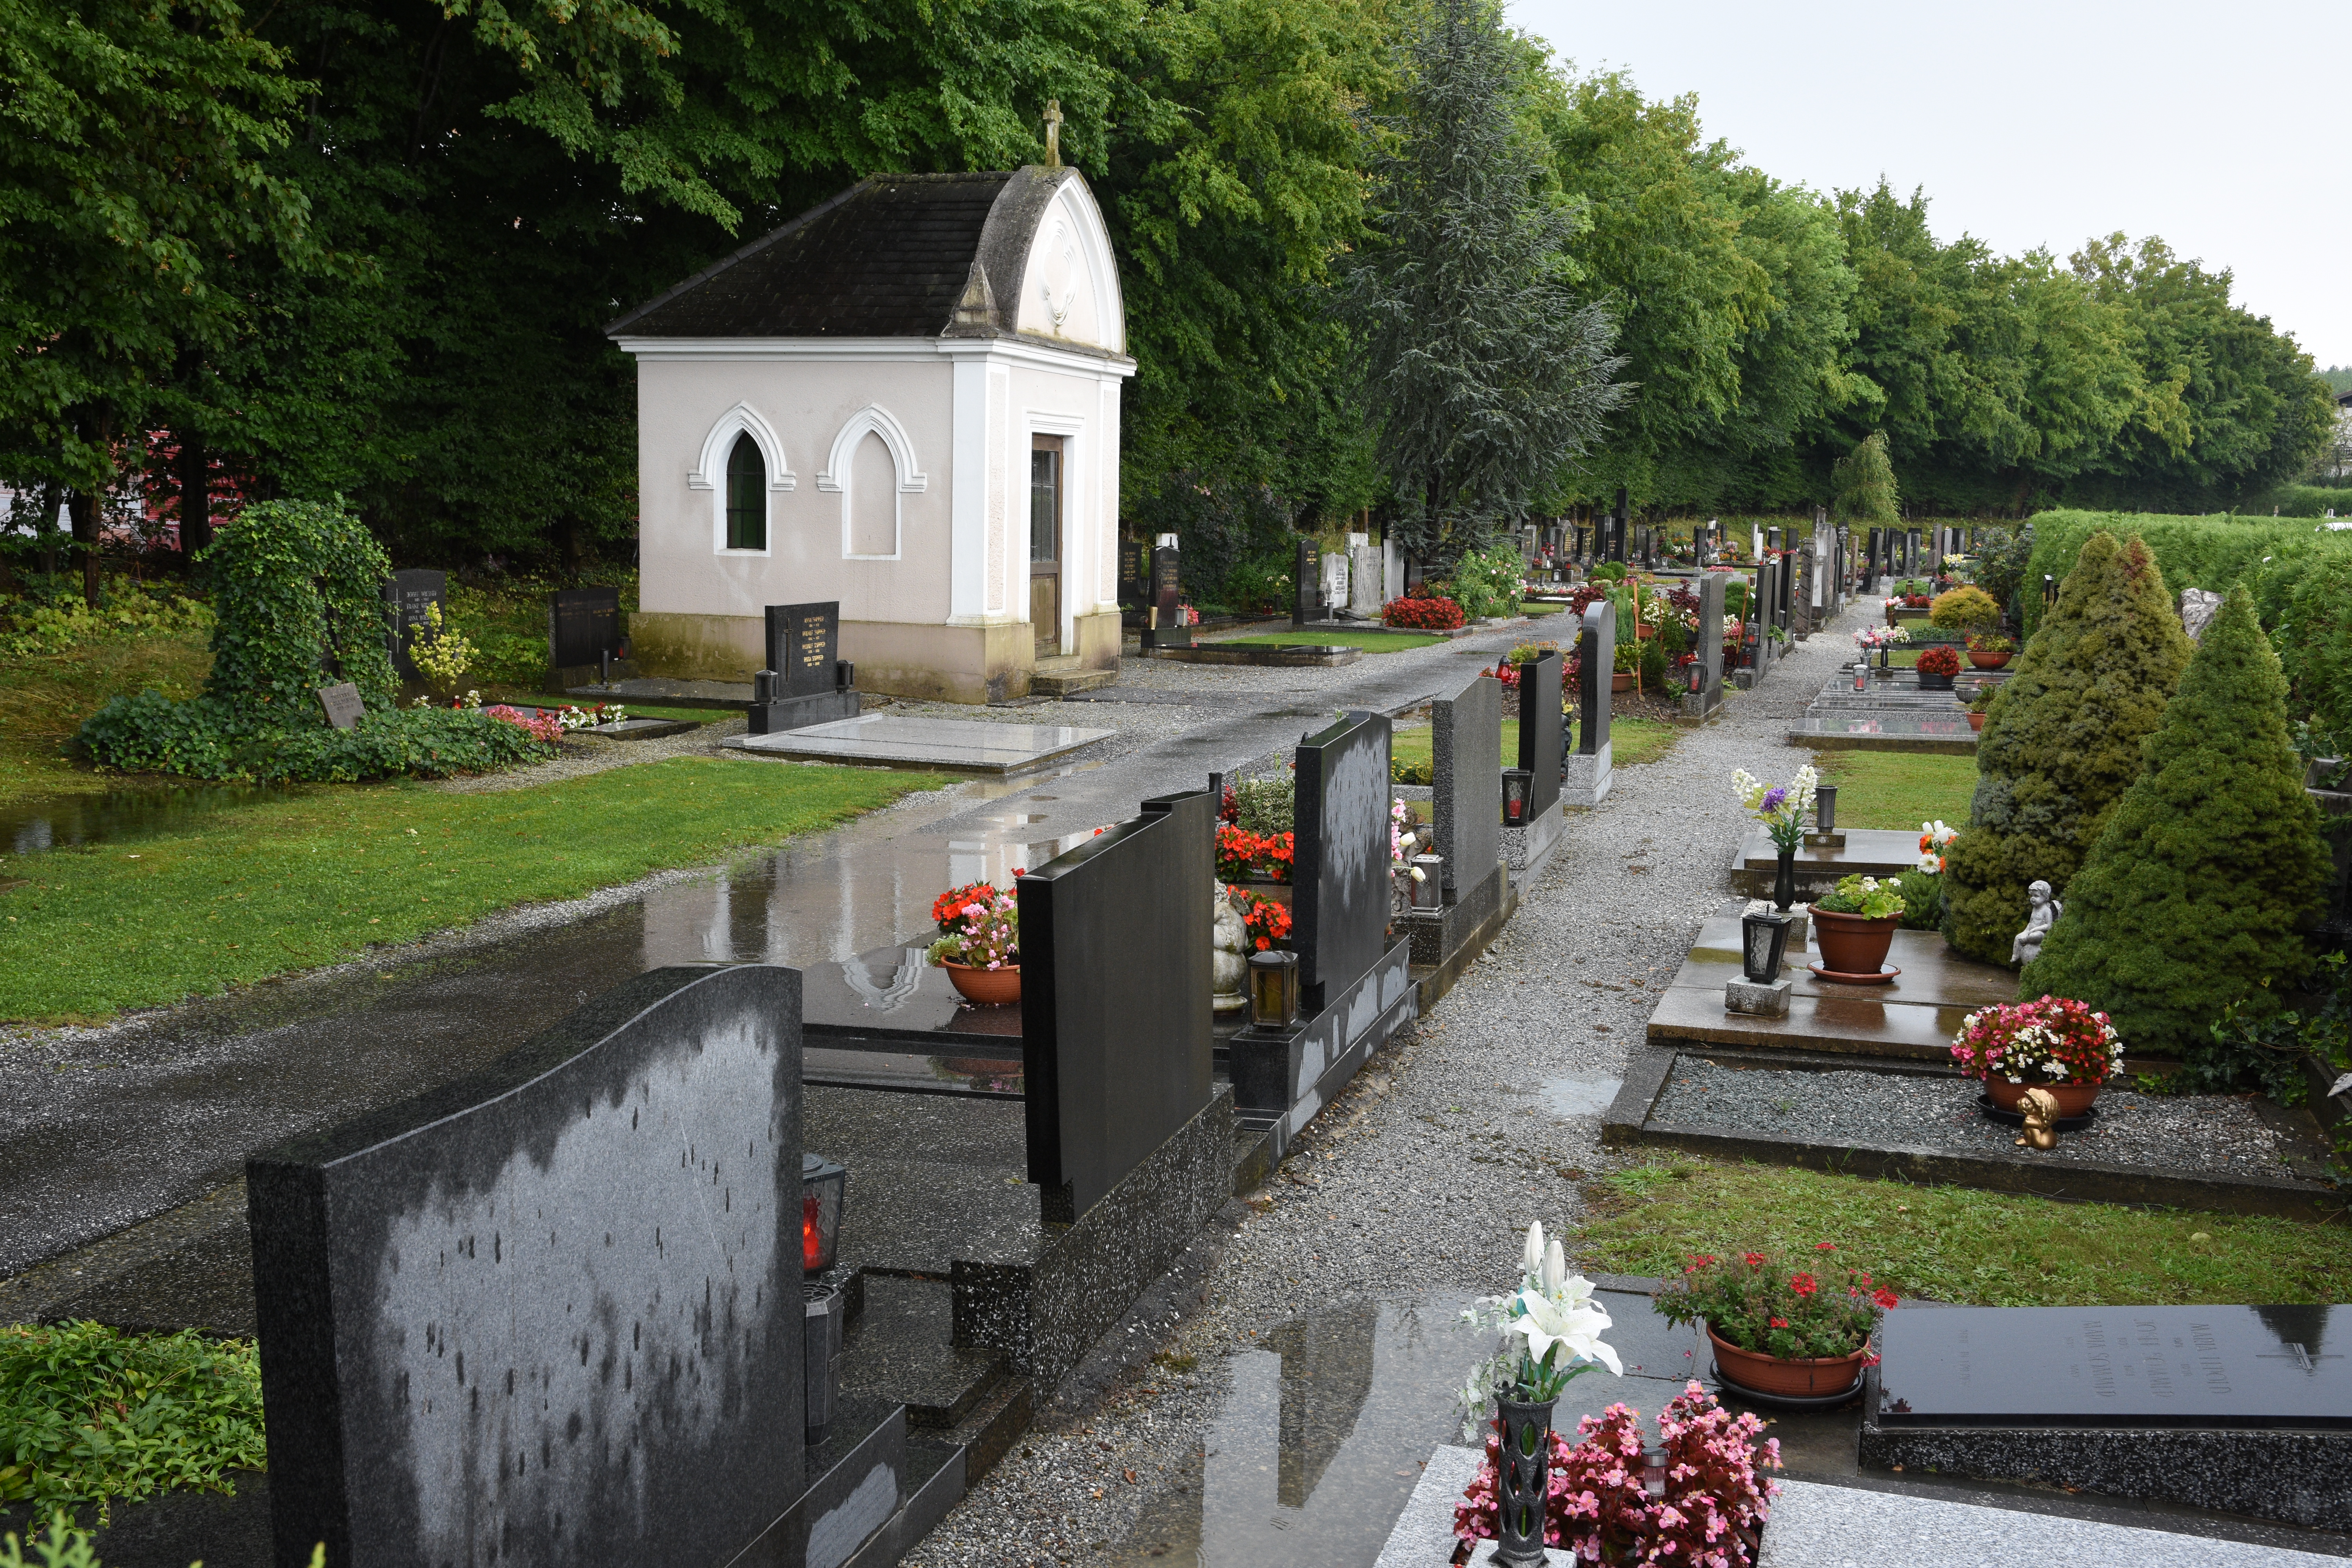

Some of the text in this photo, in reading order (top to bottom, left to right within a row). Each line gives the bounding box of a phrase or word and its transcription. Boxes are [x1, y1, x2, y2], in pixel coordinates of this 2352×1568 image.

[2081, 1320, 2117, 1397] MARIA SOMMER
[2132, 1319, 2175, 1397] JOSEF SOMMER
[2189, 1323, 2217, 1352] MARIA
